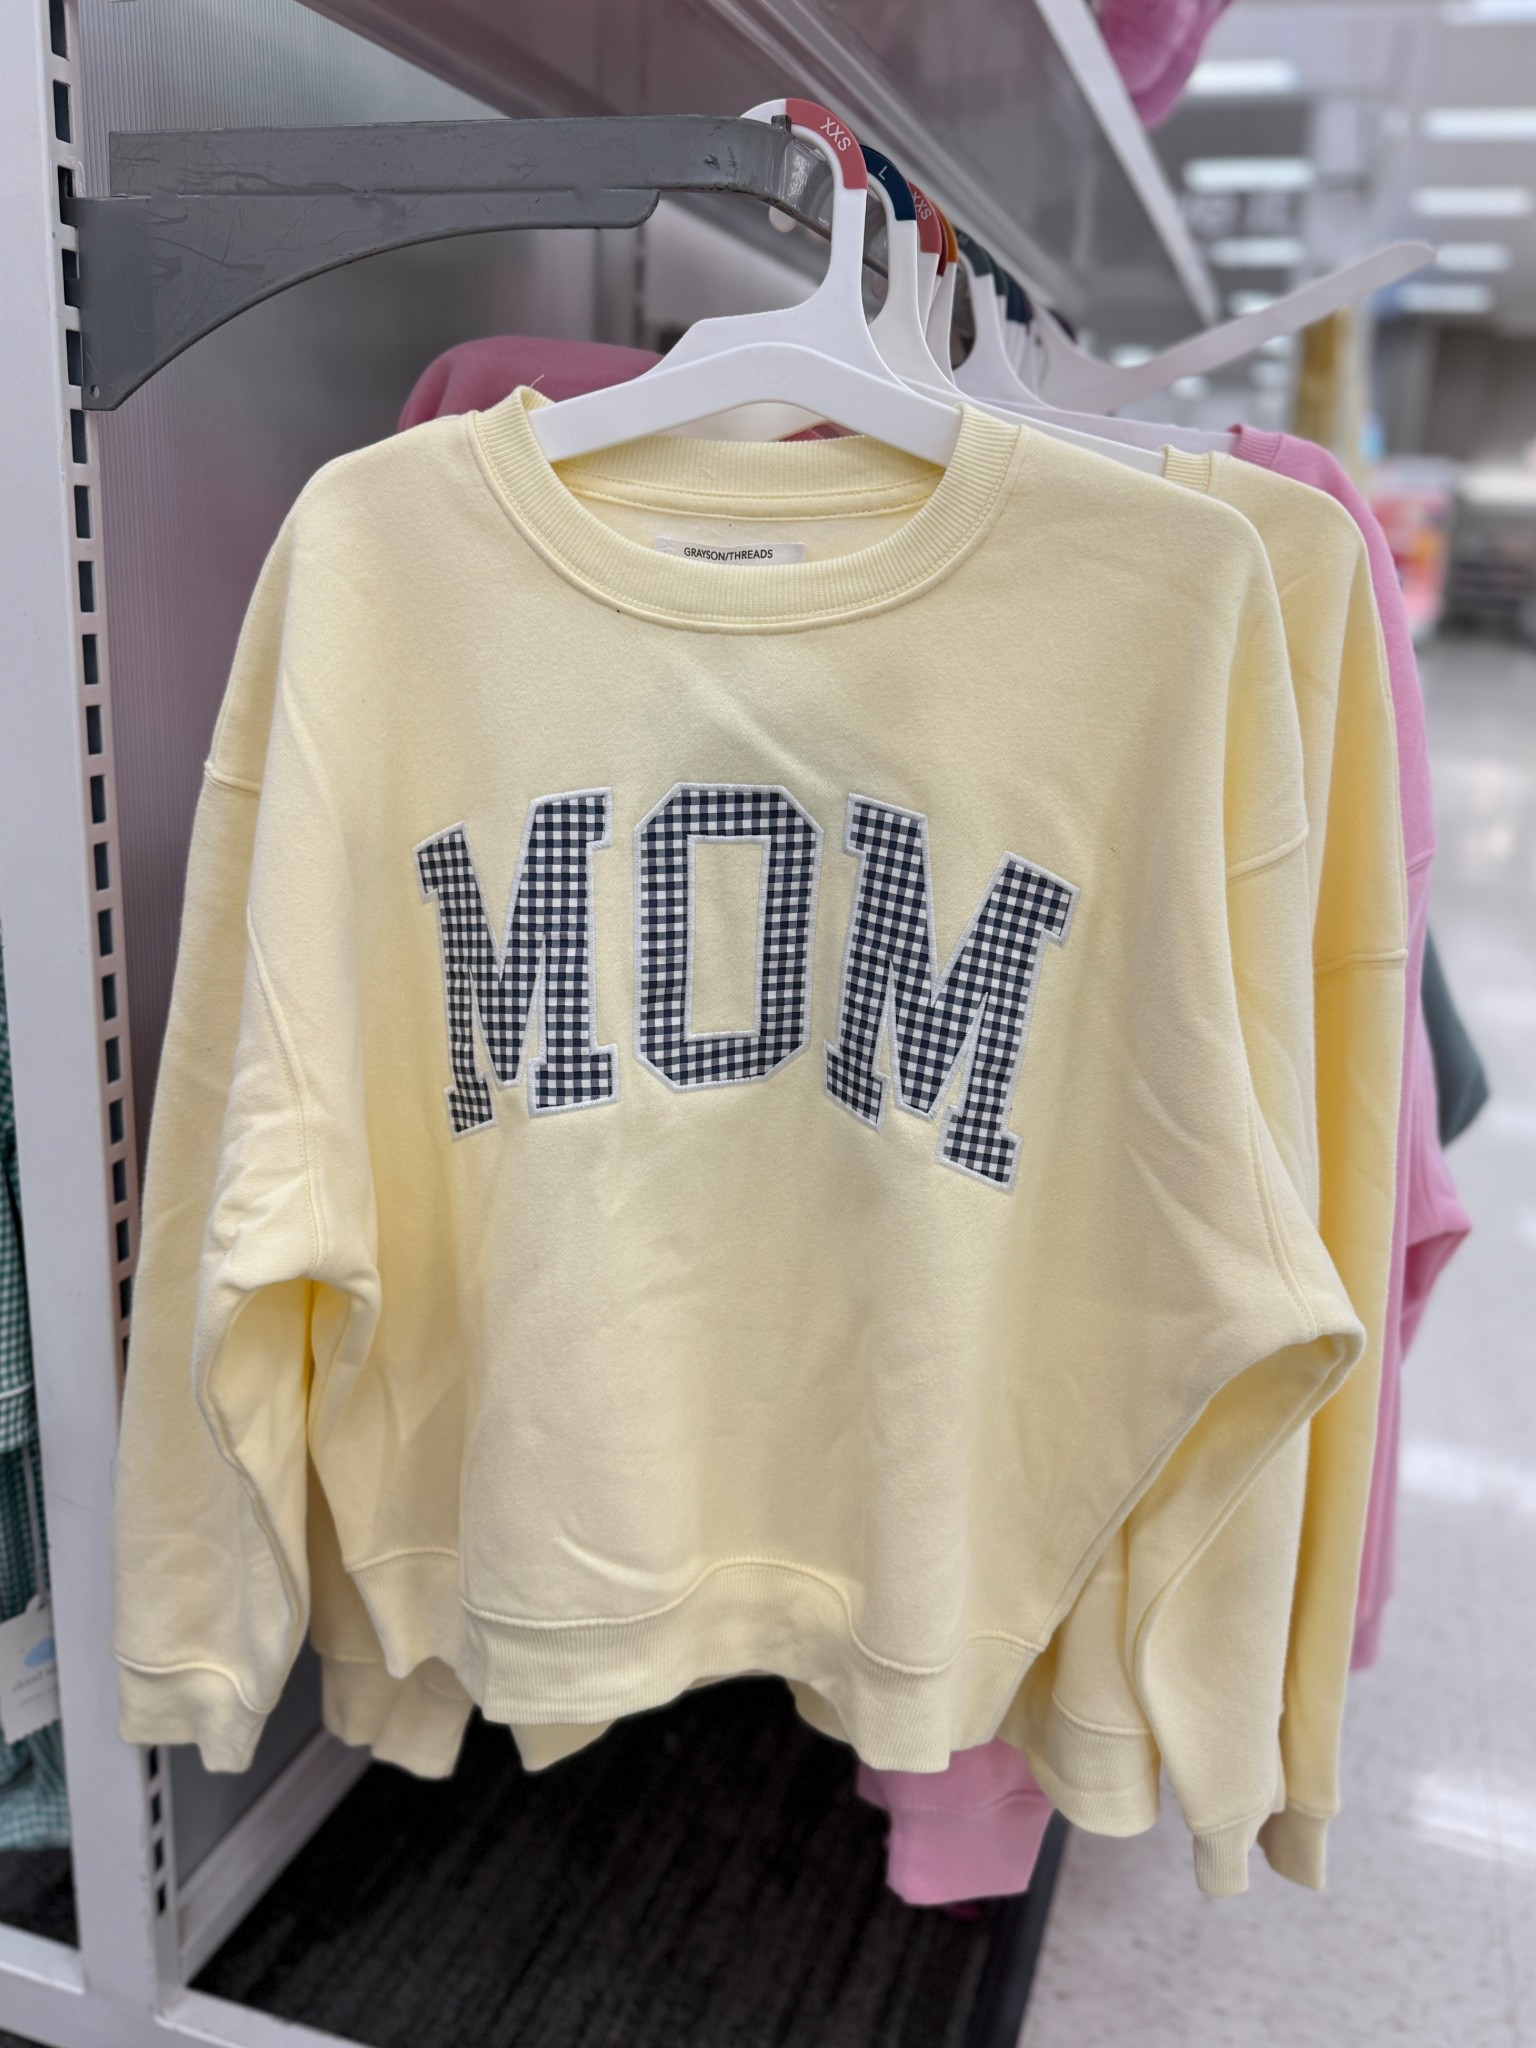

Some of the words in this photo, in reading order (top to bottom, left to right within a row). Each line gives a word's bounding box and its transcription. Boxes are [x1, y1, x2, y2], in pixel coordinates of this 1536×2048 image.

[820, 116, 851, 151] XXS
[878, 165, 888, 180] L
[684, 547, 773, 561] GRAYSON/THREADS
[412, 781, 1081, 1193] MOM
